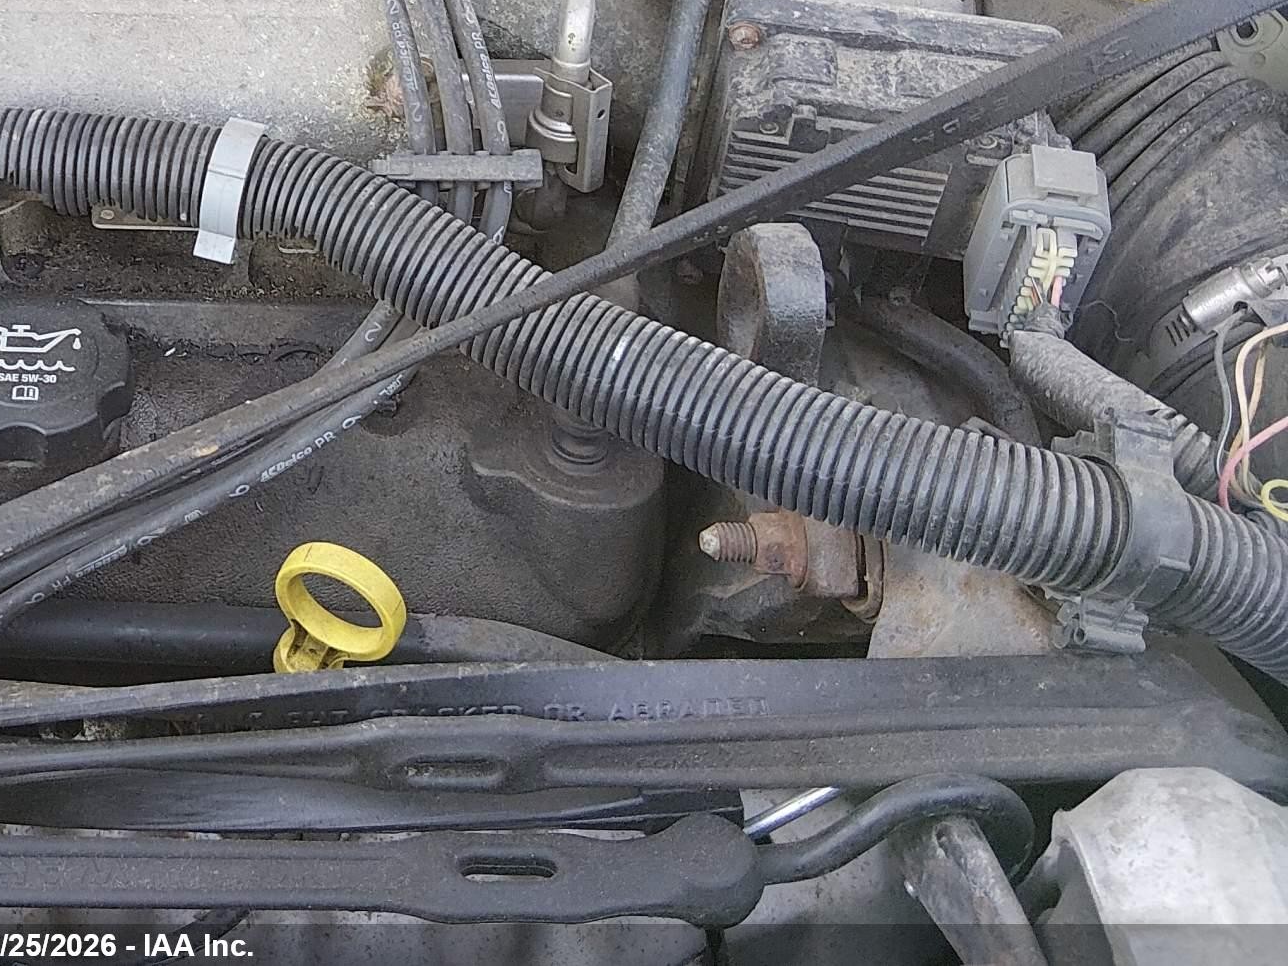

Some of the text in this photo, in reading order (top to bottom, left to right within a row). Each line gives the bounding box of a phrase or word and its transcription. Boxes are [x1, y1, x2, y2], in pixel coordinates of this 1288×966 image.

[471, 31, 485, 49] PR
[365, 321, 382, 342] 2
[21, 373, 57, 384] 5W-30
[260, 445, 313, 483] ACDelco
[314, 430, 338, 450] PR
